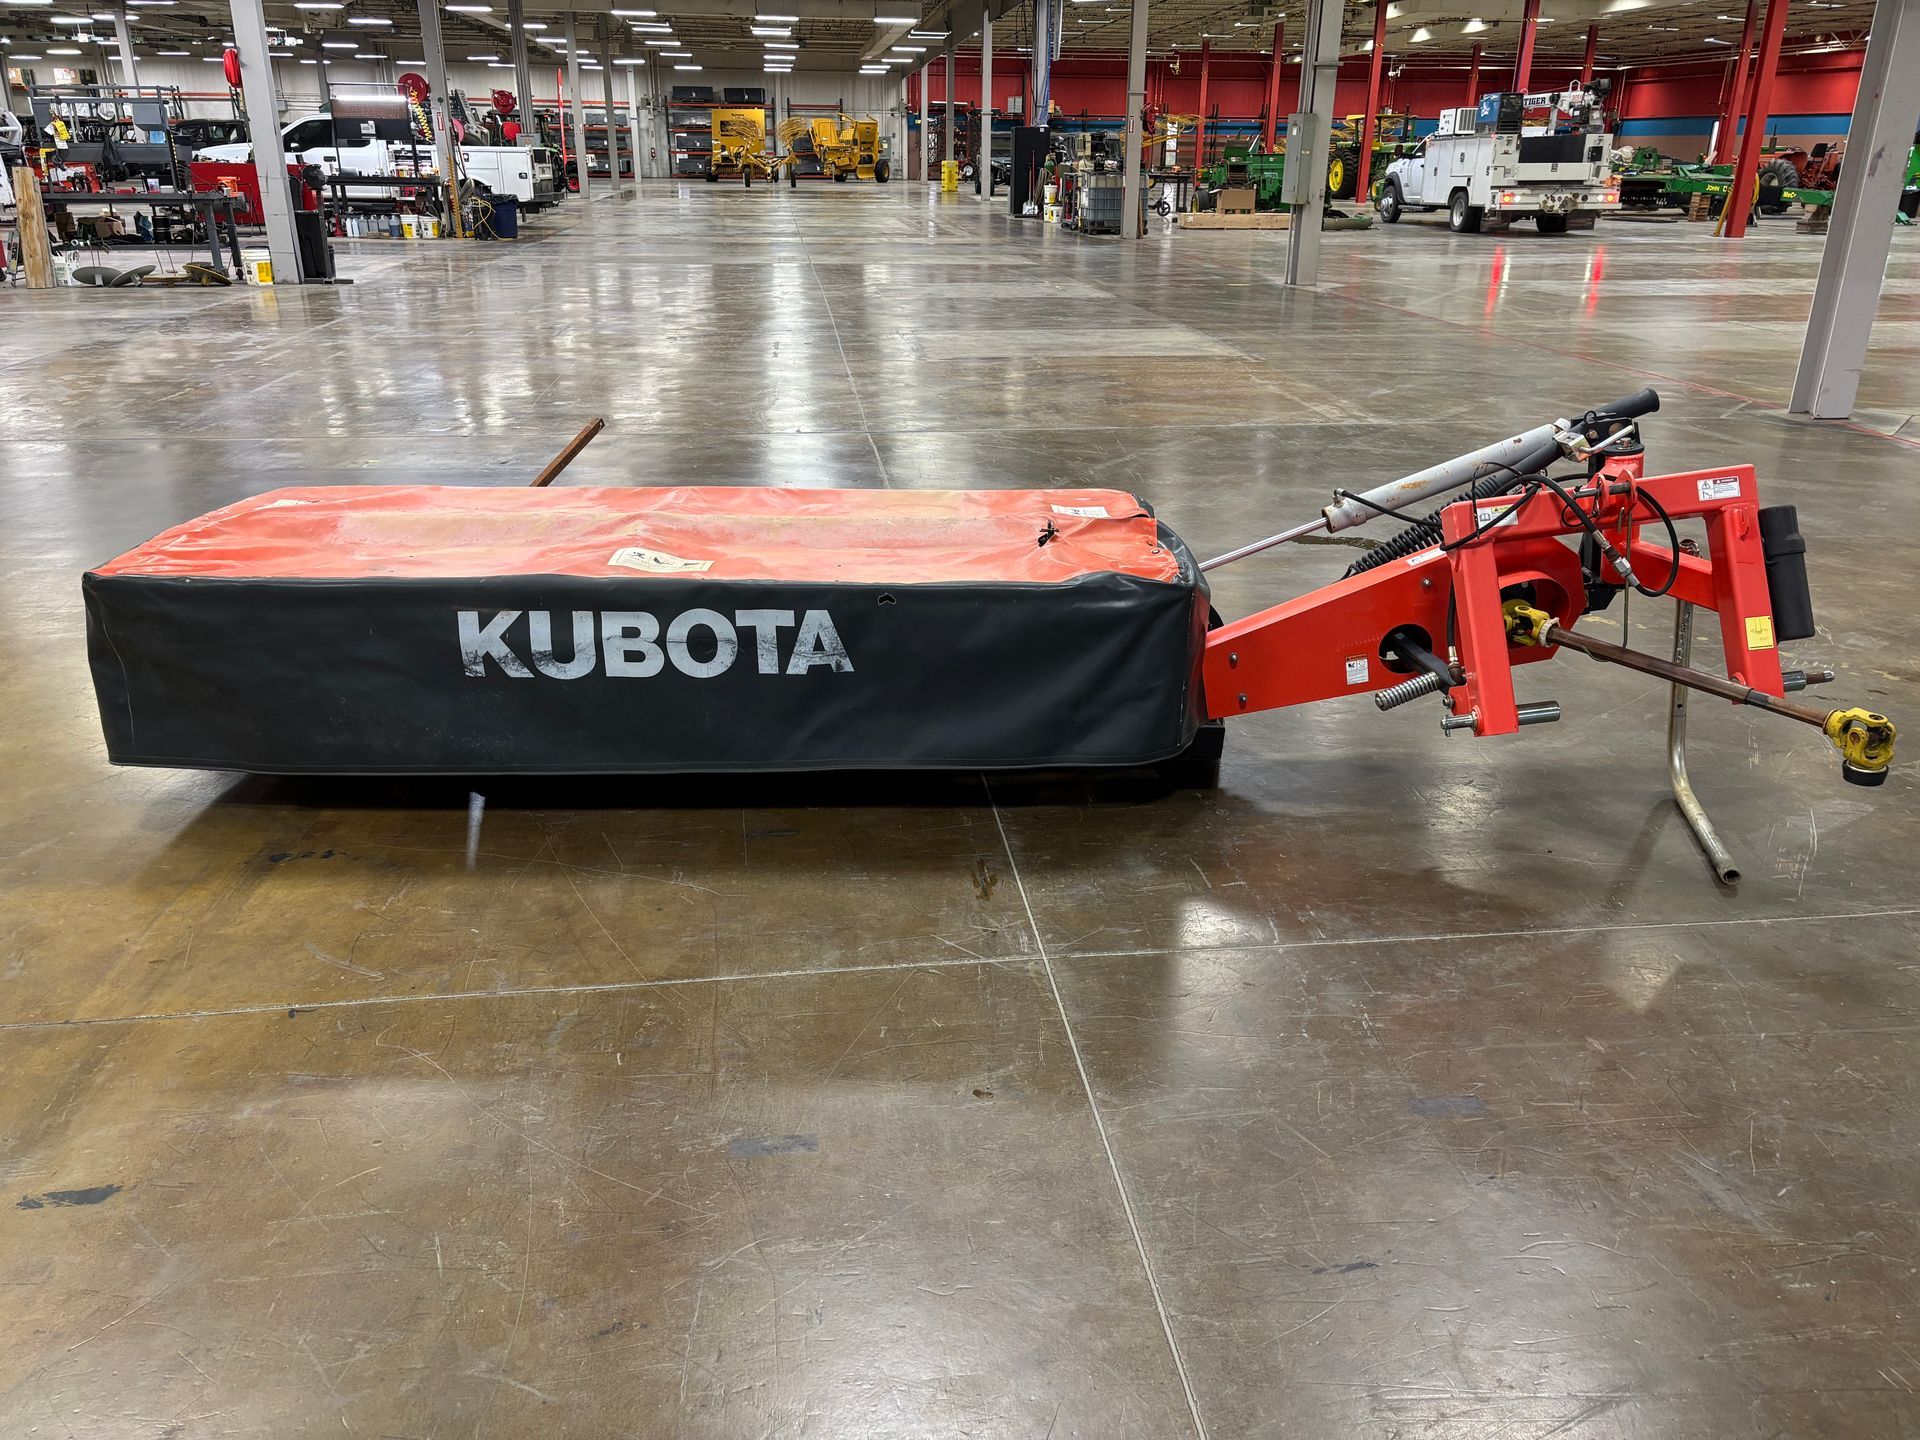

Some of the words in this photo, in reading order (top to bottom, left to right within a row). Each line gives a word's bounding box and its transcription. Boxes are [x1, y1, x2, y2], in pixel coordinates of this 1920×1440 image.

[1524, 96, 1546, 106] TIGER
[1706, 184, 1720, 192] JOHN
[457, 608, 855, 680] KUBOTA
